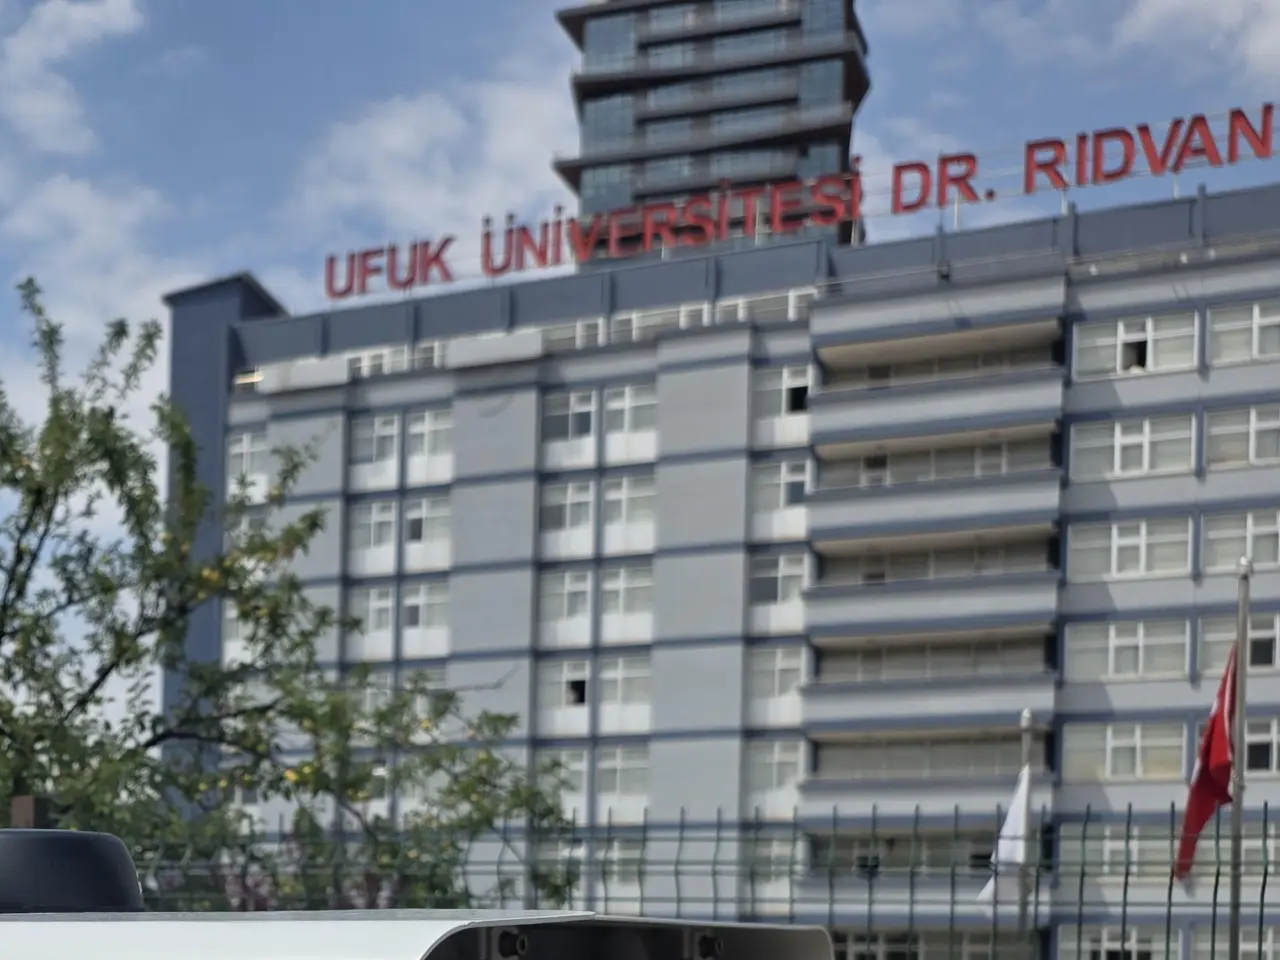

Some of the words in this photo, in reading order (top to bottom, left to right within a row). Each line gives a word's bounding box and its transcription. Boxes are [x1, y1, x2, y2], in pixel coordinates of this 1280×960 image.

[325, 235, 455, 299] UFUK
[480, 155, 864, 277] ÜNİVERSİTESİ
[892, 153, 997, 214] DR.
[1024, 103, 1275, 194] RIDVAN
